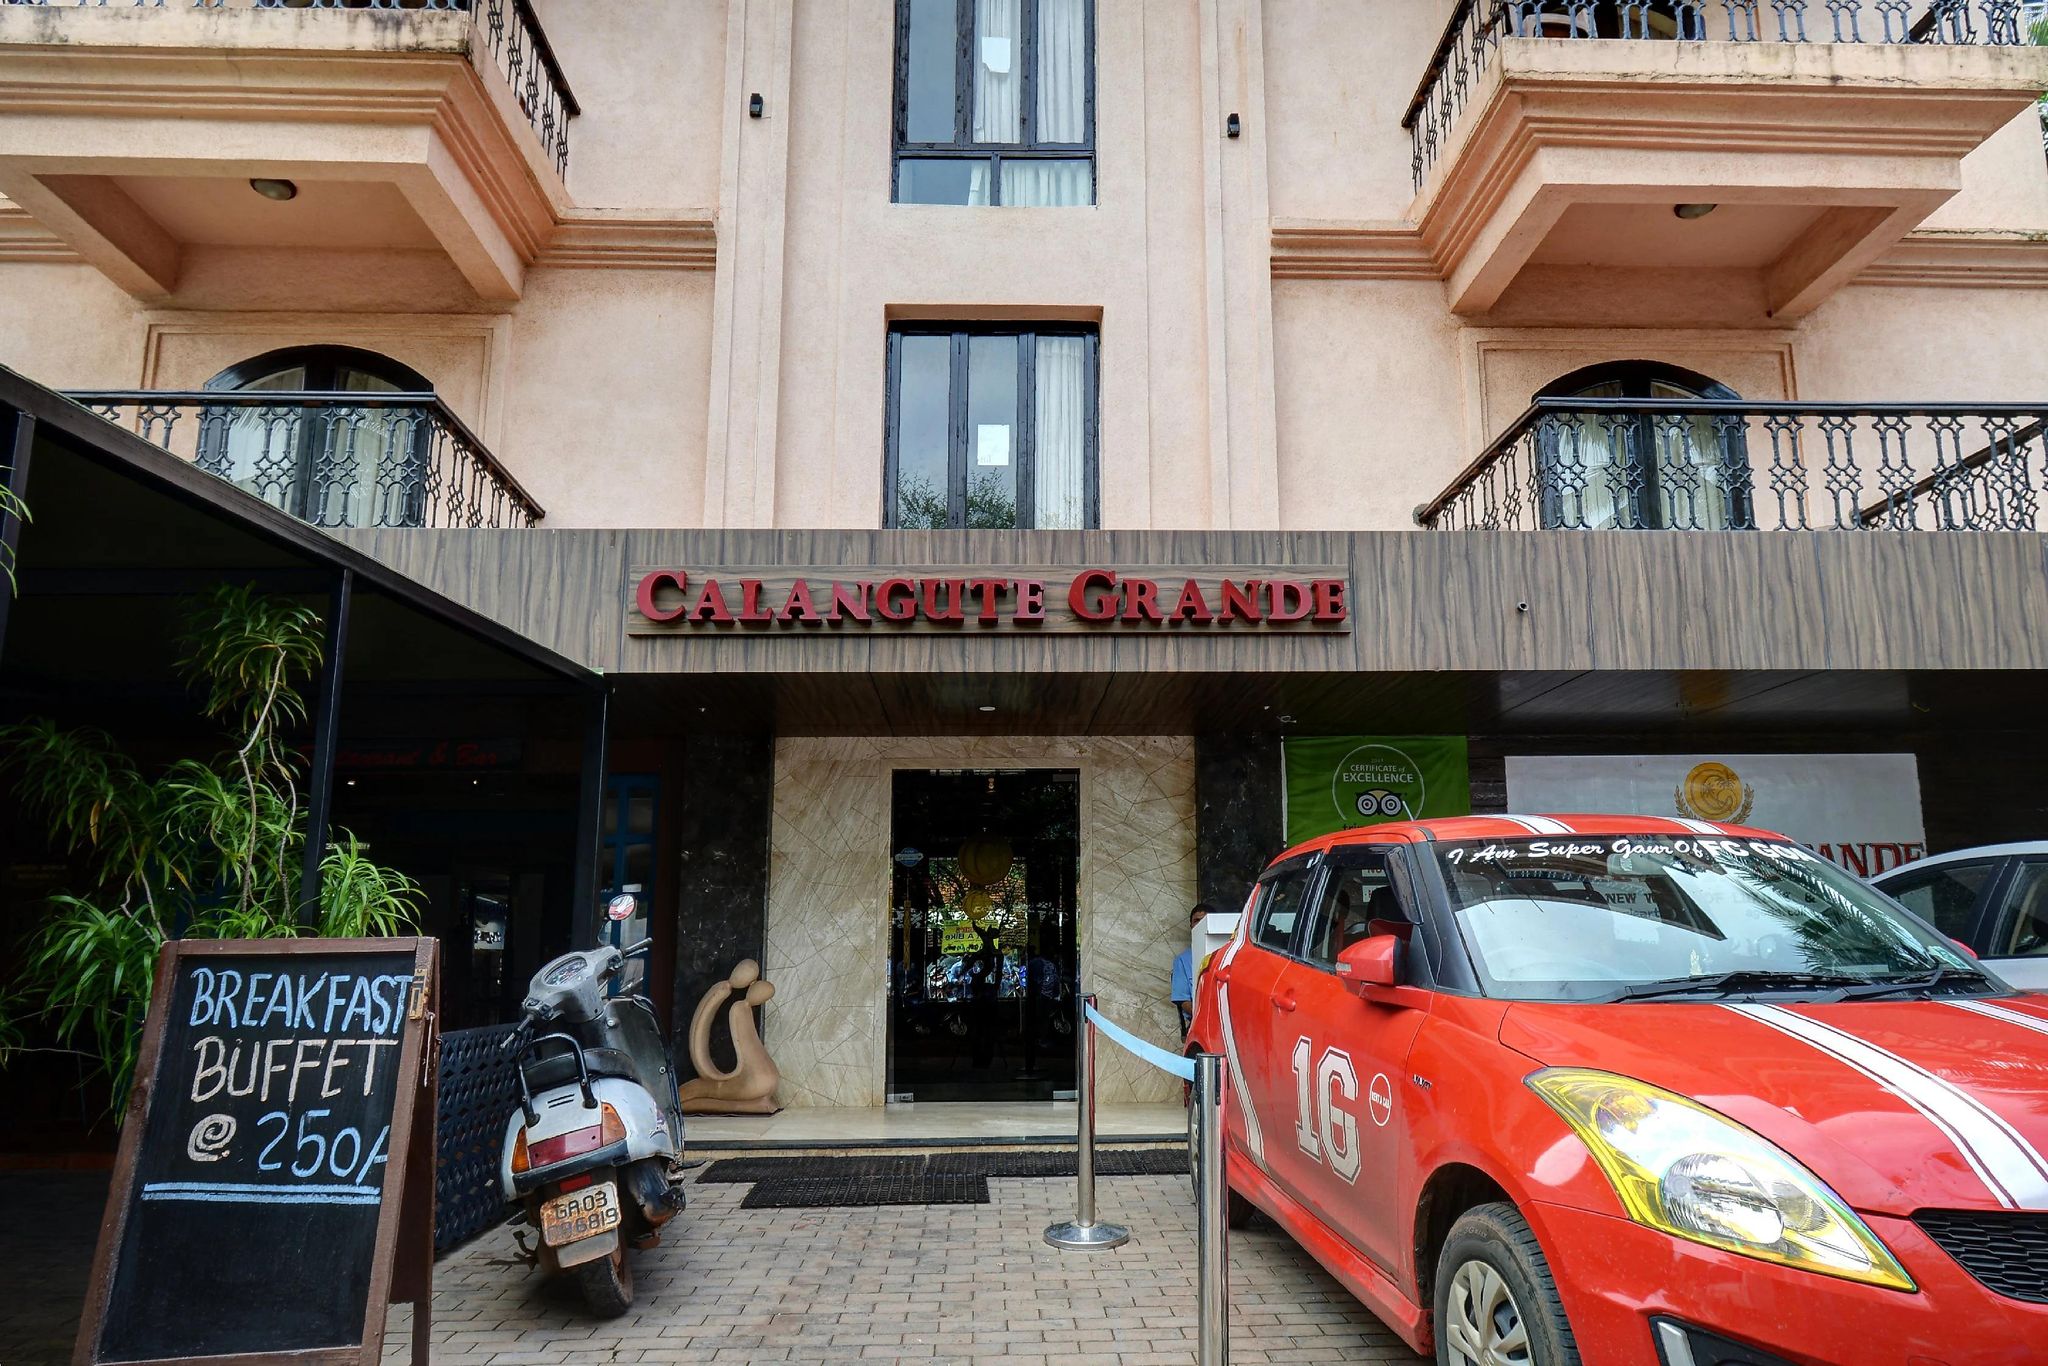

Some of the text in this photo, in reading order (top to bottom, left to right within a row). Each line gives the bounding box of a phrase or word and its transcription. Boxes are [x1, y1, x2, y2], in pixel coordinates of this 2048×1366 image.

[636, 568, 1348, 624] CALANGUTE GRANDE
[1343, 772, 1414, 783] EXCELLENCE
[1350, 764, 1397, 772] CERTIFICATE
[1469, 844, 1518, 863] Am
[1528, 842, 1604, 859] Super
[1611, 839, 1674, 860] Gaur
[1802, 842, 1926, 878] ANDE
[1606, 893, 1636, 904] NEW
[189, 967, 414, 1035] BREAKFAST
[190, 1035, 399, 1103] BUFFET
[1292, 1035, 1362, 1186] 16
[187, 1113, 237, 1162] @
